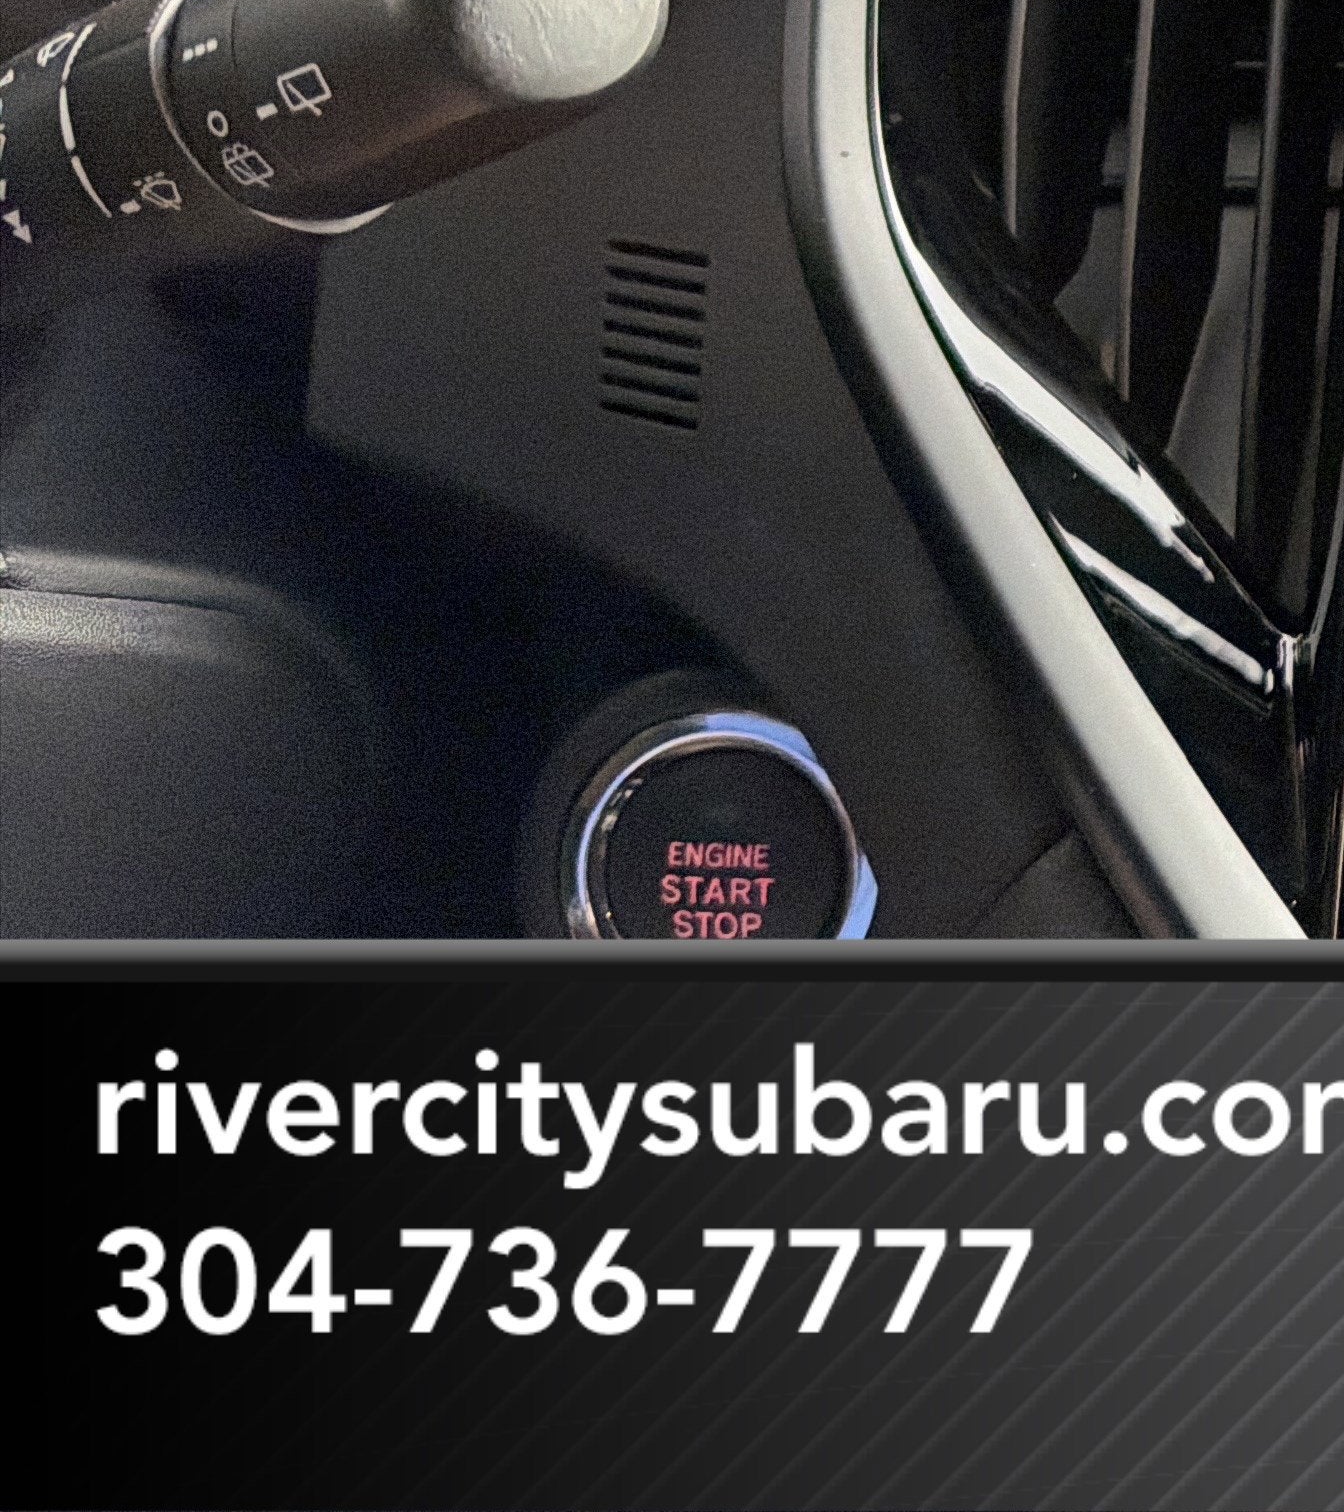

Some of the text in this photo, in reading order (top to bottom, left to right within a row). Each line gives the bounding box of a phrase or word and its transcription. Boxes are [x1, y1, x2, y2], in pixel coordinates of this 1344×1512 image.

[668, 841, 770, 870] ENGINE
[659, 873, 775, 907] START
[672, 910, 763, 940] STOP
